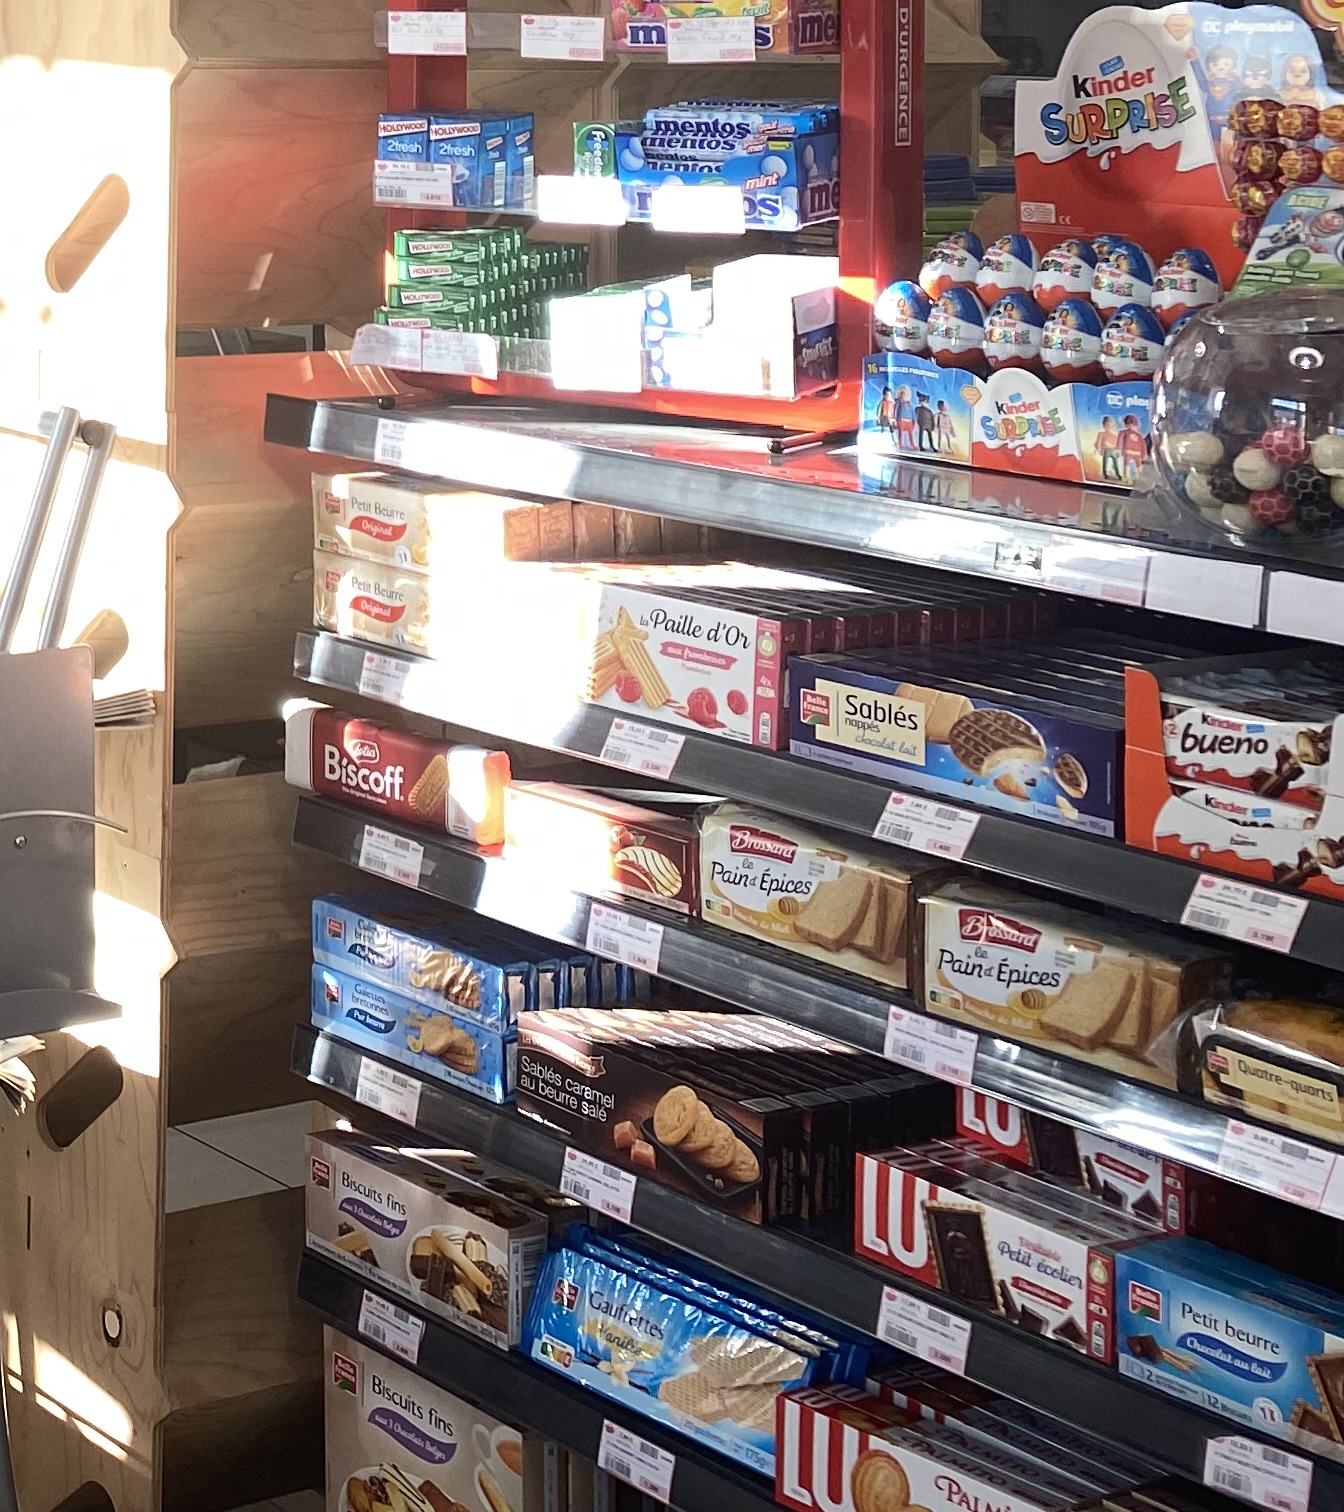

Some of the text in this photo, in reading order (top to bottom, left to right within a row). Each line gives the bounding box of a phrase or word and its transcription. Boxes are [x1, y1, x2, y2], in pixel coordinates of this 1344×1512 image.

[742, 2, 770, 17] fruit
[896, 10, 909, 144] D'URGENCE
[1072, 67, 1155, 99] Kinder
[1041, 76, 1196, 145] SURPRISE
[380, 121, 427, 133] HOLLYWOOD
[432, 124, 480, 137] HOLLYWOOD
[654, 118, 751, 138] mentos
[387, 140, 423, 154] 2fresh
[439, 143, 475, 157] 2fresh
[745, 172, 779, 190] mint
[412, 243, 451, 251] HOLLYWOOD
[412, 267, 451, 275] HOLLYWOOD
[403, 293, 442, 302] HOLLYWOOD
[867, 363, 878, 373] 16
[995, 400, 1041, 416] Kinder
[980, 408, 1066, 442] SURPRISE
[351, 497, 405, 520] Petit Beurre
[361, 519, 393, 537] Original
[352, 576, 404, 602] Petit Beurre
[361, 600, 392, 618] Original
[650, 608, 704, 638] Paille
[707, 621, 751, 650] d'Or
[803, 701, 829, 715] France
[805, 693, 828, 707] Belle
[844, 695, 918, 731] Sablés
[1202, 713, 1243, 732] Kinder
[844, 717, 880, 734] nappés
[855, 733, 918, 758] chocolat lait
[1180, 723, 1269, 755] bueno
[324, 744, 404, 801] Biscoff
[1205, 794, 1249, 816] Kinder
[732, 830, 797, 858] Brossard
[742, 858, 754, 870] le
[712, 861, 812, 896] Pain Épices
[974, 945, 988, 960] le
[938, 948, 1061, 989] Pain Épices
[351, 994, 389, 1016] bretonnes
[353, 1010, 385, 1030] Pur beurre
[521, 1055, 615, 1109] Sablés caramel
[1237, 1058, 1335, 1103] Quatre-quarts
[520, 1075, 607, 1122] au beurre salé
[342, 1171, 406, 1216] Biscuits fins
[863, 1156, 929, 1269] LU
[997, 1240, 1083, 1289] Petit écolier
[589, 1291, 665, 1340] Gaufrettes
[1181, 1302, 1280, 1356] Petit beurre
[1187, 1338, 1272, 1380] Chocolat au lait
[1146, 1368, 1155, 1384] 2
[372, 1374, 454, 1437] Biscuits fins
[1207, 1392, 1220, 1410] 12
[783, 1398, 860, 1512] LU
